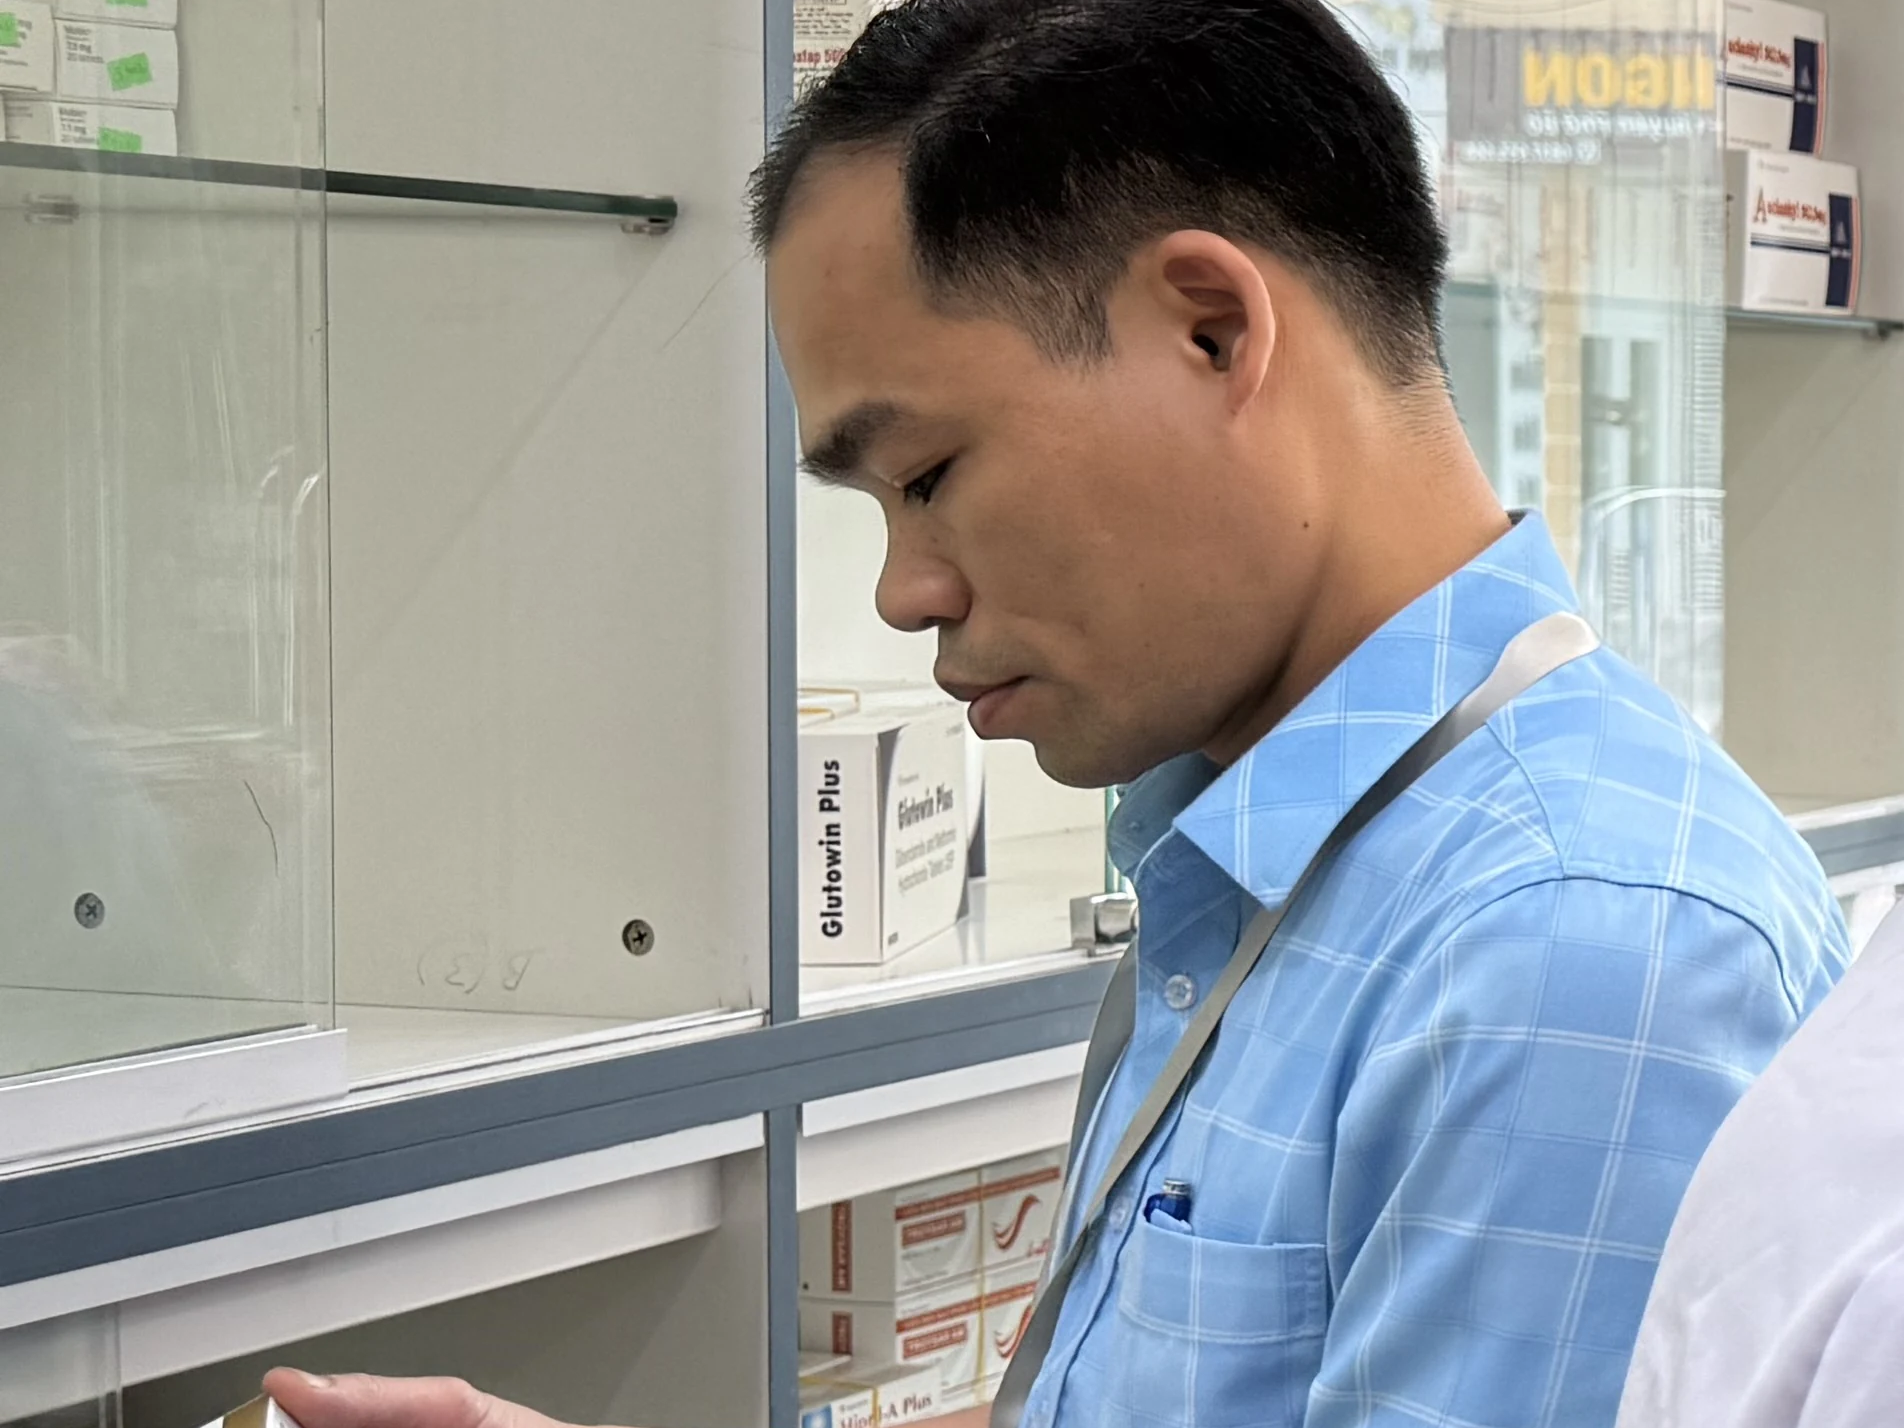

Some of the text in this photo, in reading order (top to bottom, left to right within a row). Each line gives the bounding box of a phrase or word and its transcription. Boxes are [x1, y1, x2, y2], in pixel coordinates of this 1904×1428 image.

[817, 759, 844, 939] Glutowin Plus
[903, 1393, 933, 1415] Plus
